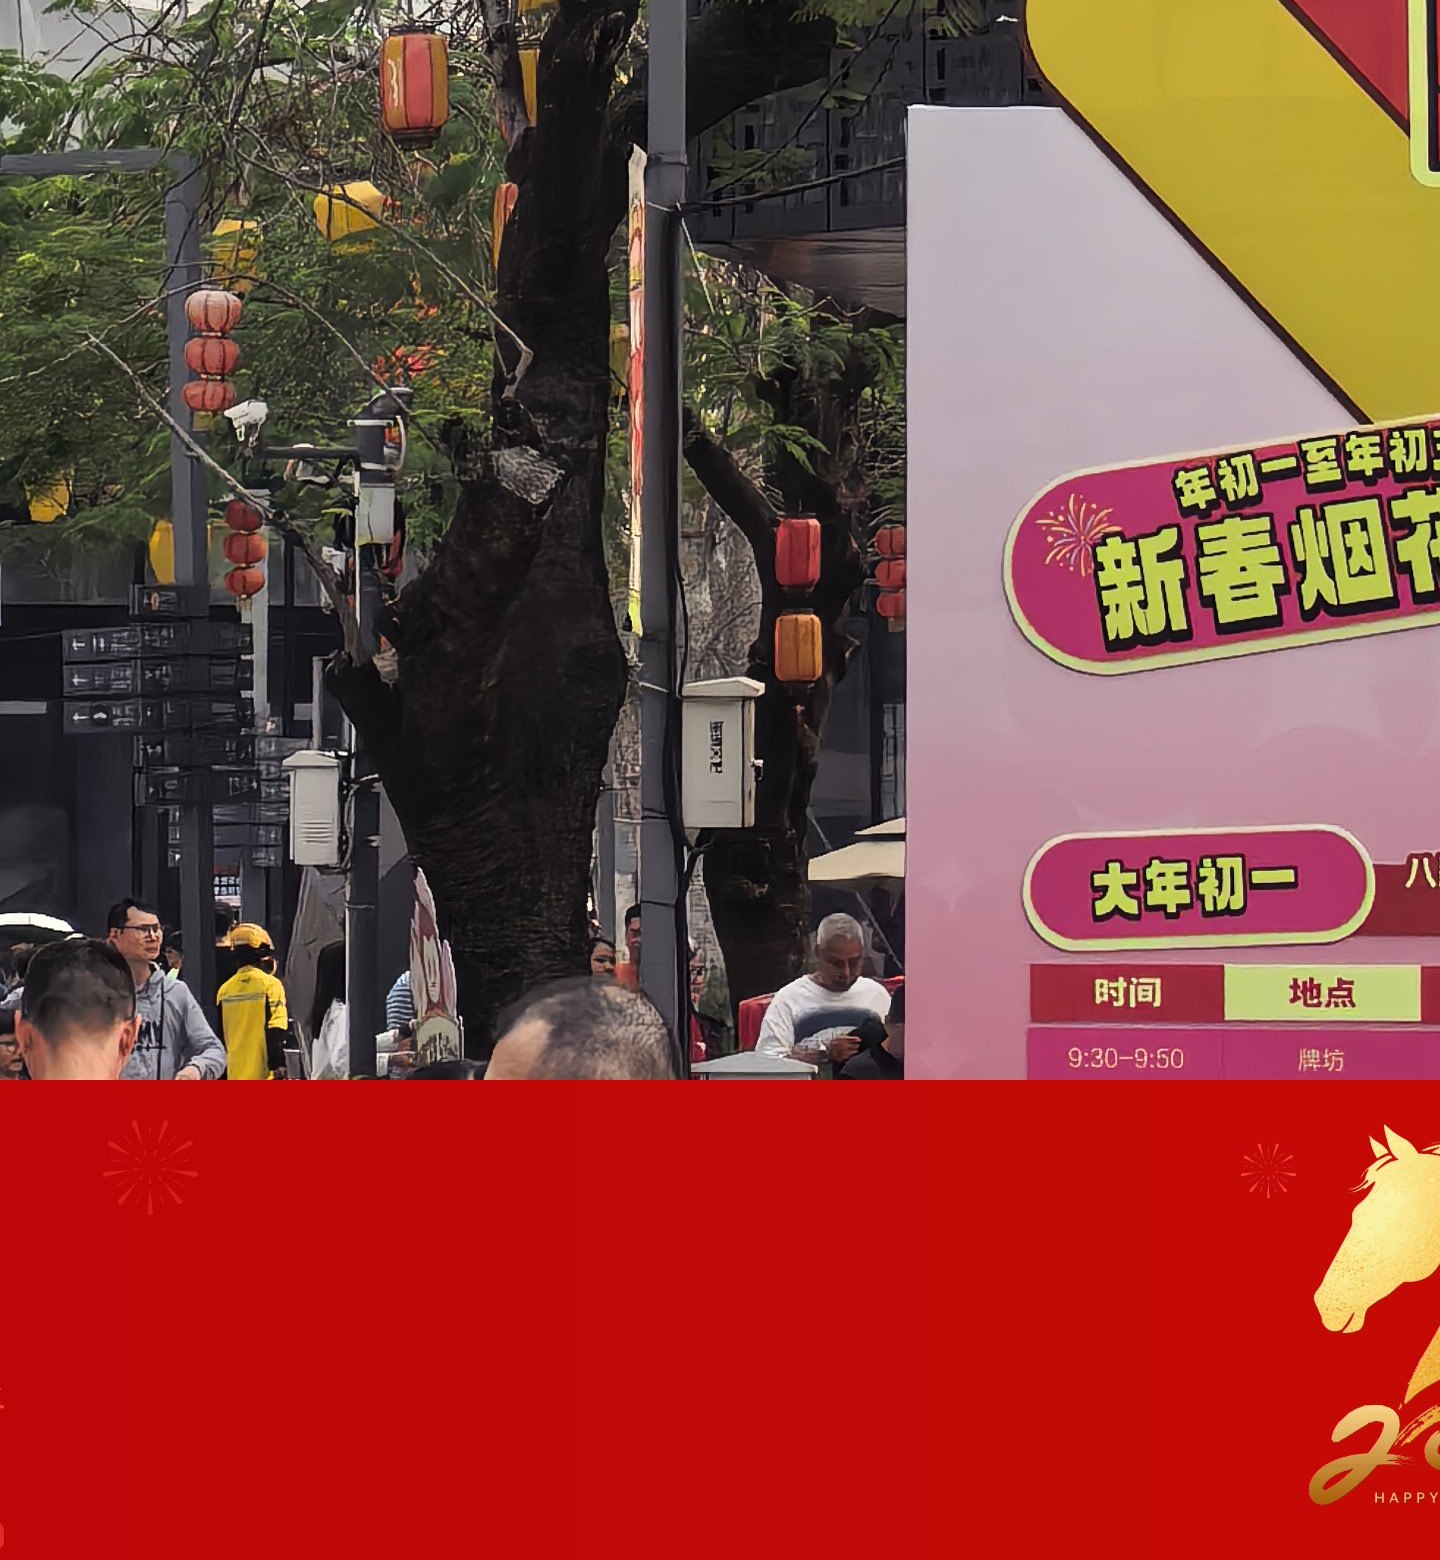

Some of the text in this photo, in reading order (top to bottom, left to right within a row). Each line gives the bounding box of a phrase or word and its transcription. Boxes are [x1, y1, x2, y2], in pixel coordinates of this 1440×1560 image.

[1092, 856, 1298, 920] 大年初一
[1094, 976, 1163, 1010] 时间
[1288, 977, 1356, 1010] 地点
[1067, 1046, 1185, 1072] 9:30-9:50
[1297, 1048, 1346, 1074] 牌坊
